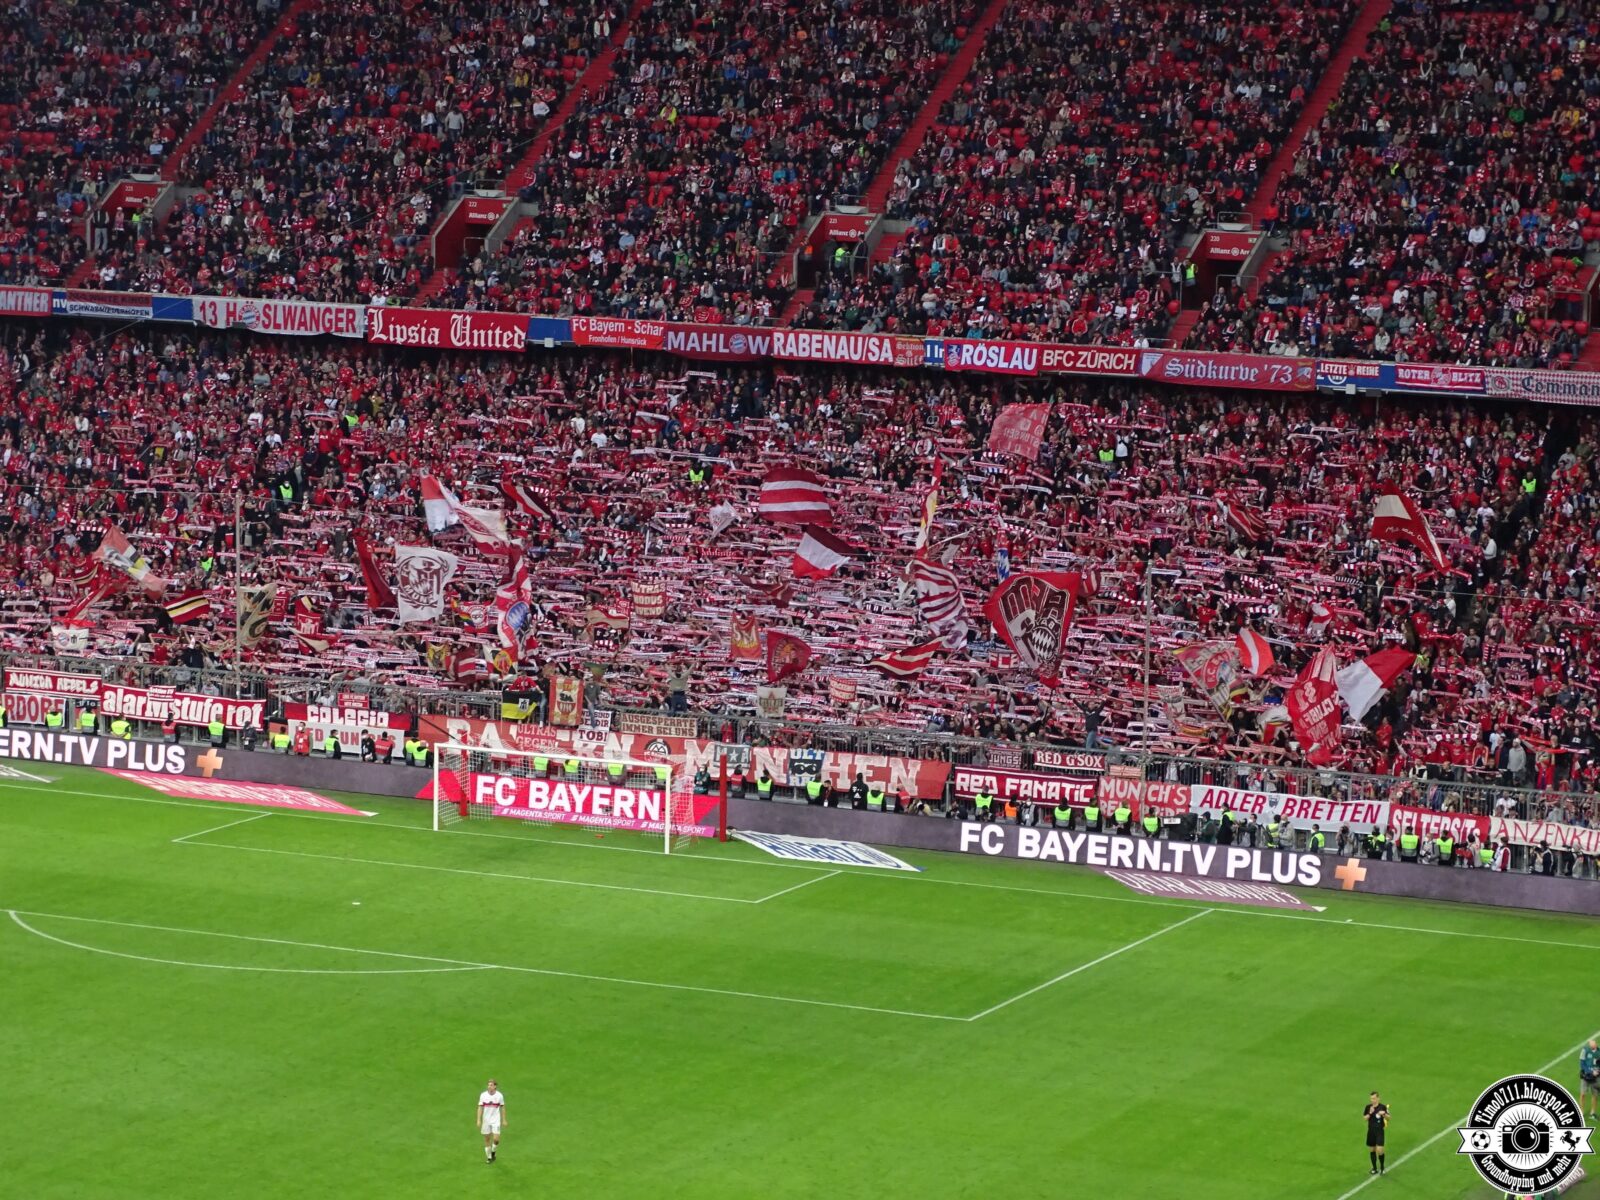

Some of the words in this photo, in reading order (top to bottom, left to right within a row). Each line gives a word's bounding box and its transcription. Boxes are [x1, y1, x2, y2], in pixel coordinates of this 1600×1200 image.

[199, 301, 218, 327] 13
[367, 308, 441, 345] Lipsia
[450, 313, 526, 349] United
[573, 318, 587, 332] FC
[589, 318, 625, 335] Bayern
[634, 321, 664, 337] Schar
[773, 332, 894, 363] RABENAU/SA
[960, 343, 1037, 371] RÖSLAU
[1042, 350, 1074, 367] BFC
[1076, 350, 1136, 371] ZÜRICH
[1164, 357, 1259, 382] Südkurve
[1320, 362, 1348, 375] LETZTE
[1356, 365, 1380, 377] REIHE
[1398, 368, 1431, 380] ROTER
[1451, 371, 1482, 383] BLITZ
[57, 677, 99, 694] REBELS
[226, 703, 263, 729] rot
[622, 712, 695, 728] AUSGESPERRTE
[517, 724, 556, 737] ULTRAS
[579, 729, 607, 742] TOBI
[622, 723, 654, 735] IMMER
[656, 725, 672, 736] BEI
[673, 727, 695, 737] UNS
[107, 739, 186, 775] PLUS
[1036, 751, 1062, 765] RED
[1066, 753, 1103, 769] G'SOX
[475, 775, 516, 806] FC
[528, 780, 661, 821] BAYERN
[1200, 788, 1268, 815] ADLER
[1280, 798, 1381, 824] BRETTEN
[960, 822, 1005, 856] FC
[1017, 827, 1217, 876] BAYERN.TV
[1226, 848, 1322, 887] PLUS
